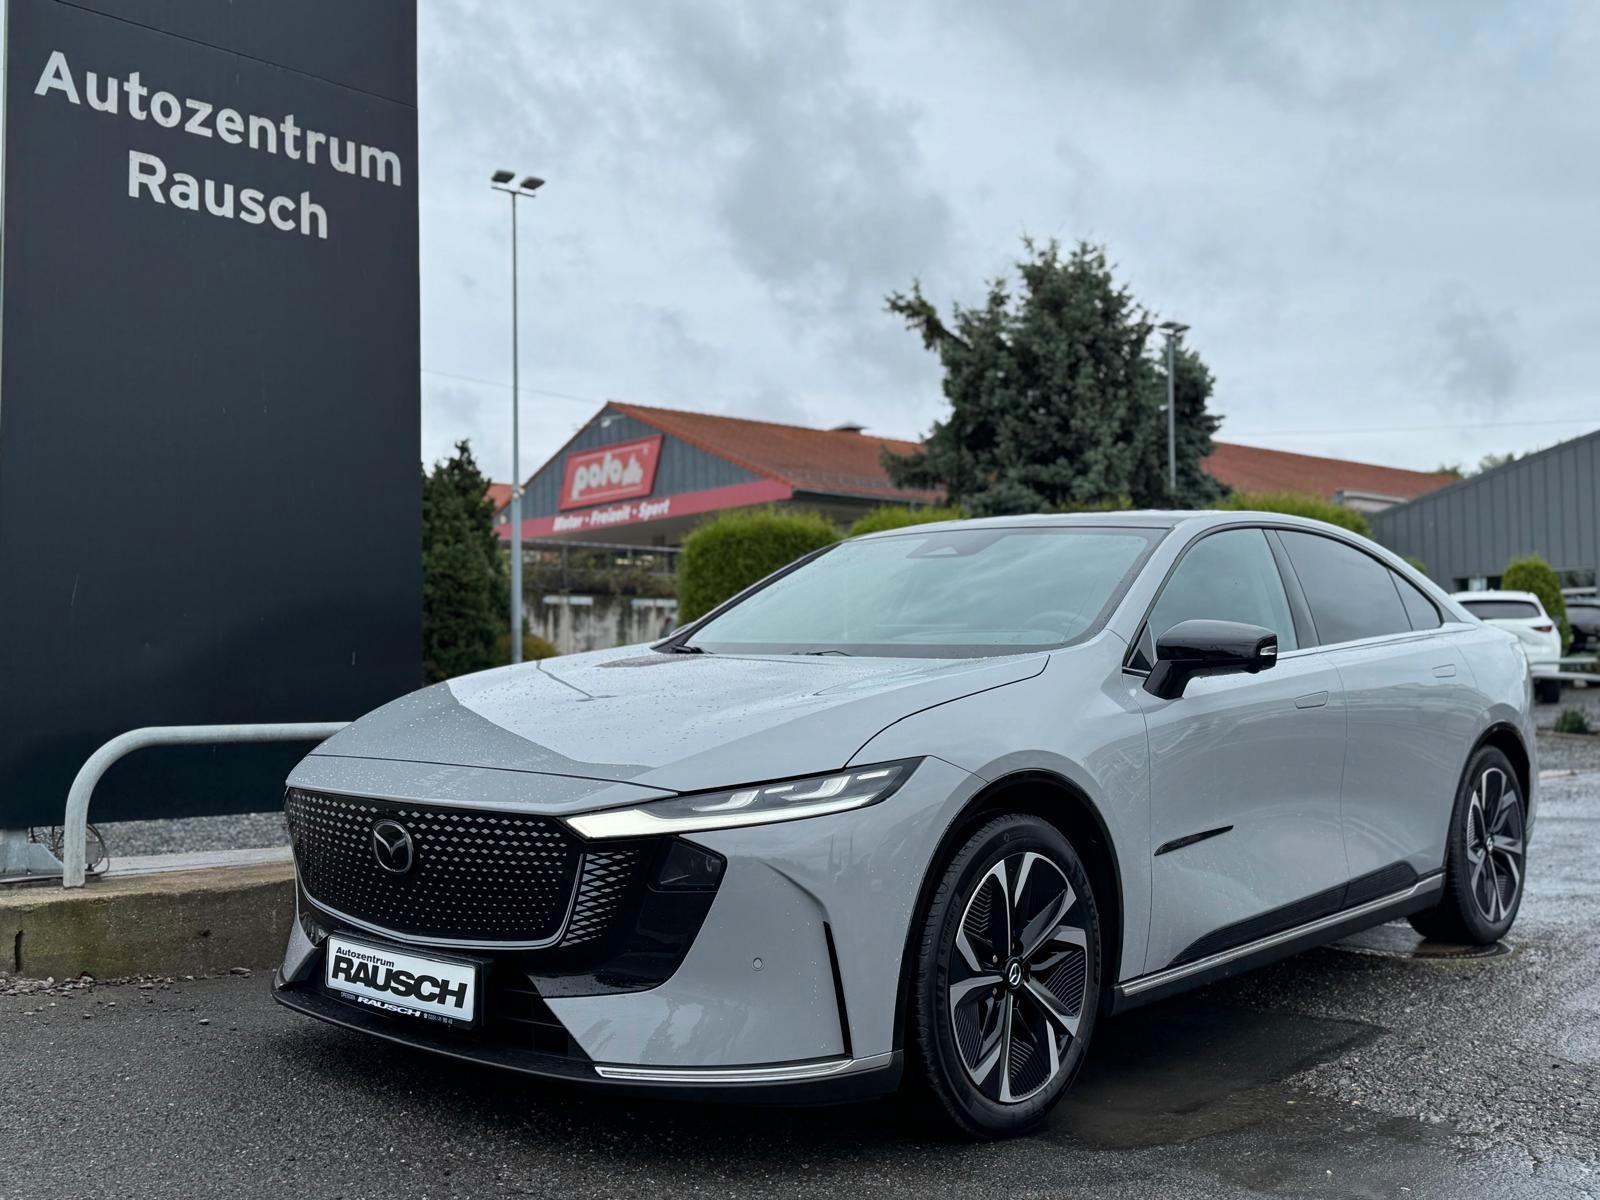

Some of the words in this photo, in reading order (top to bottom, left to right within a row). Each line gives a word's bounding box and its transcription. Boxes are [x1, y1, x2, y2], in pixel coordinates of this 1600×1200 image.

[34, 50, 402, 187] Autozentrum
[128, 150, 328, 239] Rausch
[571, 452, 623, 501] polo
[638, 499, 670, 520] Sport
[332, 955, 468, 1009] RAUSCH
[336, 947, 395, 968] Autozentrum
[357, 997, 420, 1018] RAUSCH
